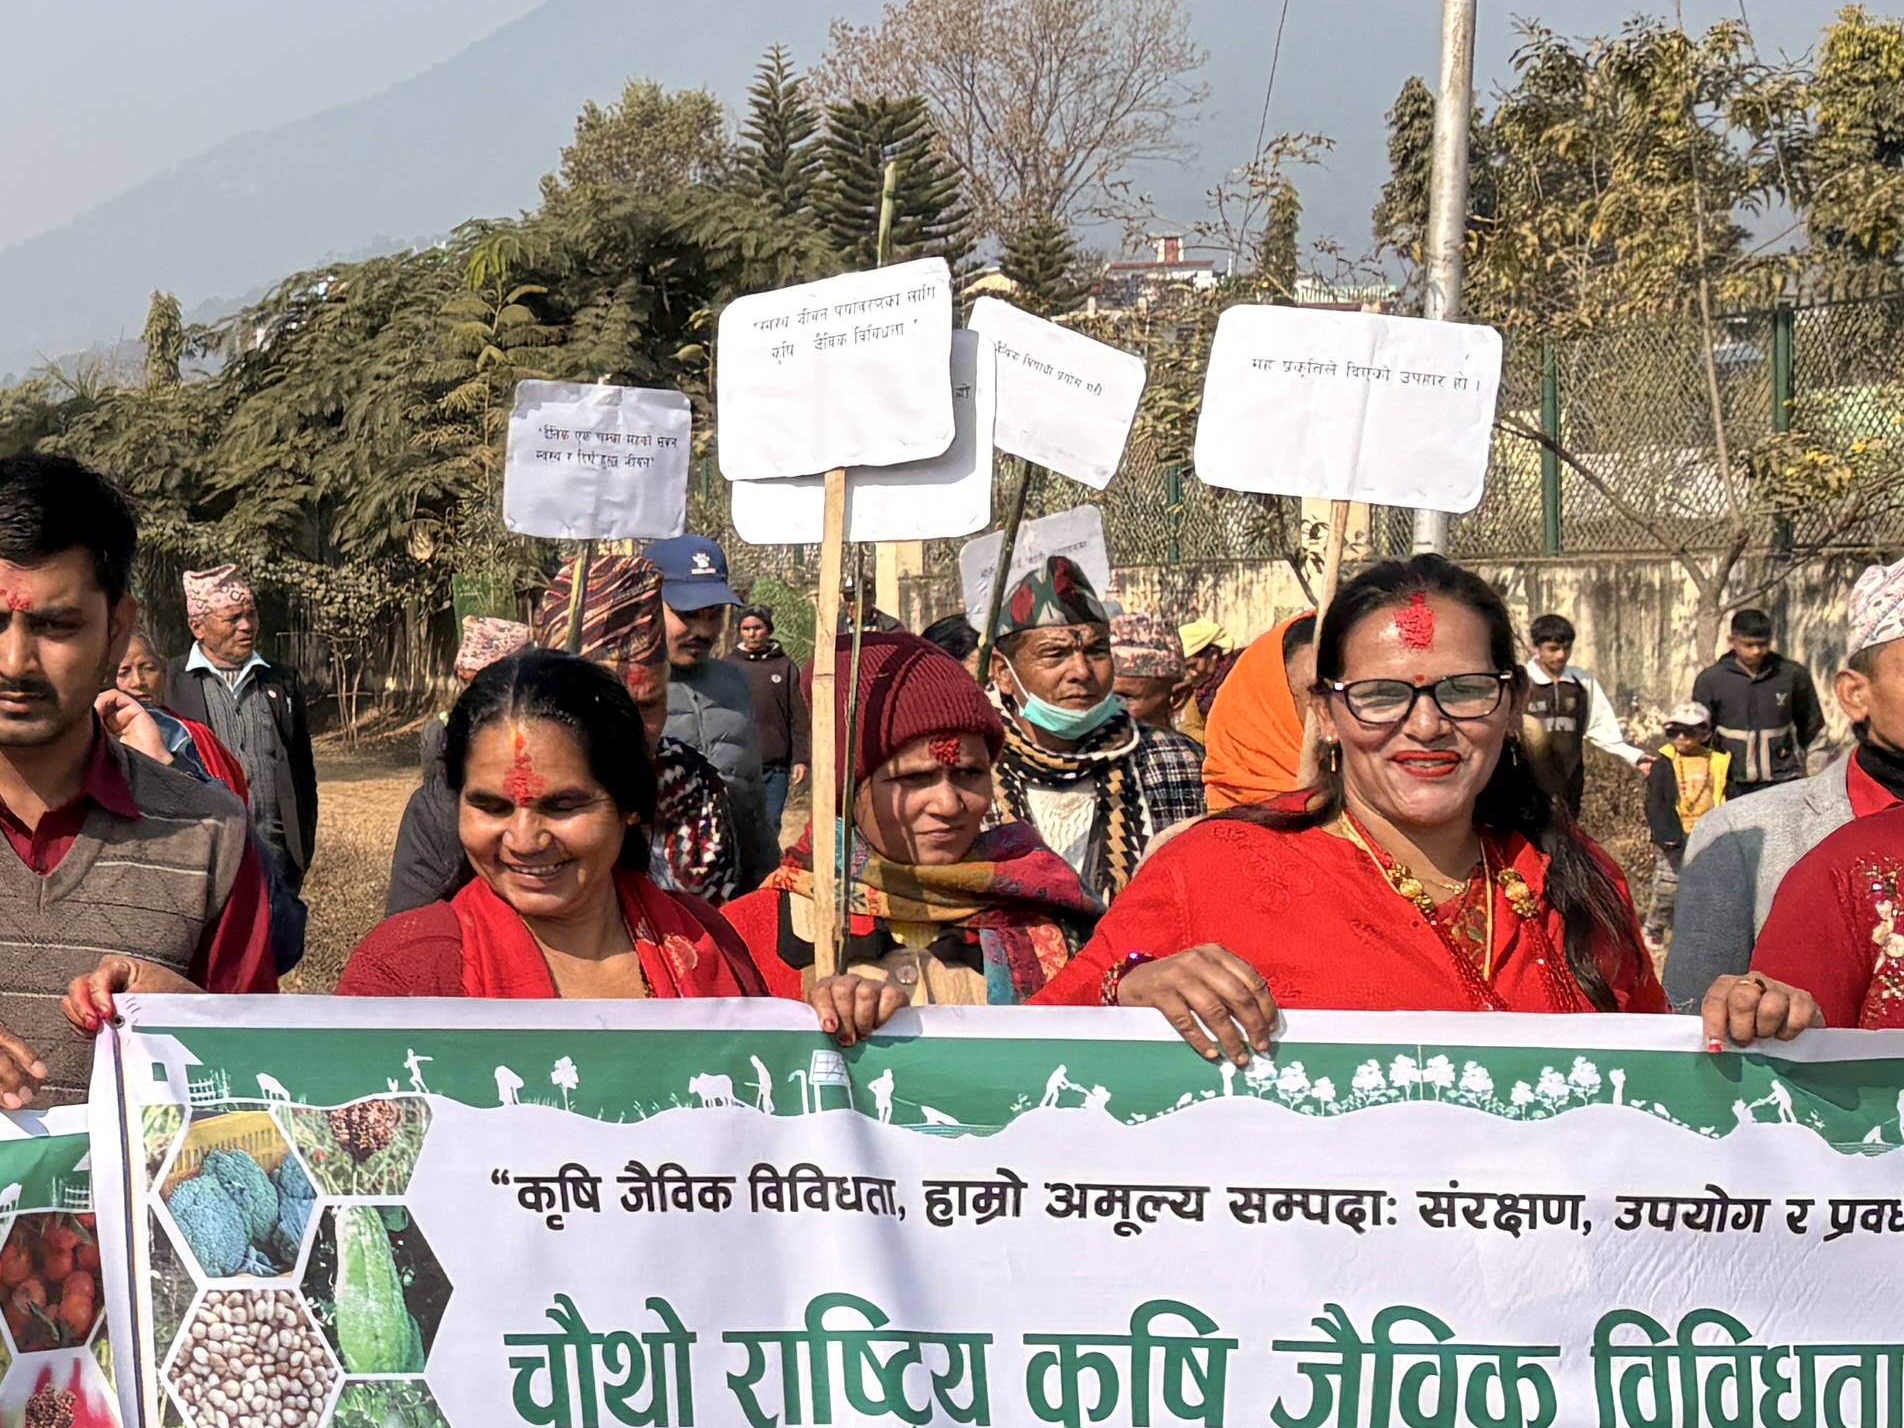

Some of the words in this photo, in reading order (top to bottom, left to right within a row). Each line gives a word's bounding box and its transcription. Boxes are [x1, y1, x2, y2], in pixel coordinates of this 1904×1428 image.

[490, 1162, 603, 1231] “कृषि
[615, 1159, 737, 1213] जैविक
[747, 1162, 906, 1222] विविधता,
[921, 1167, 1029, 1228] हाम्रो
[1043, 1182, 1211, 1238] अमूल्य
[1415, 1179, 1592, 1239] संरक्षण,
[1614, 1183, 1772, 1234] उपयोग
[1785, 1198, 1816, 1235] र
